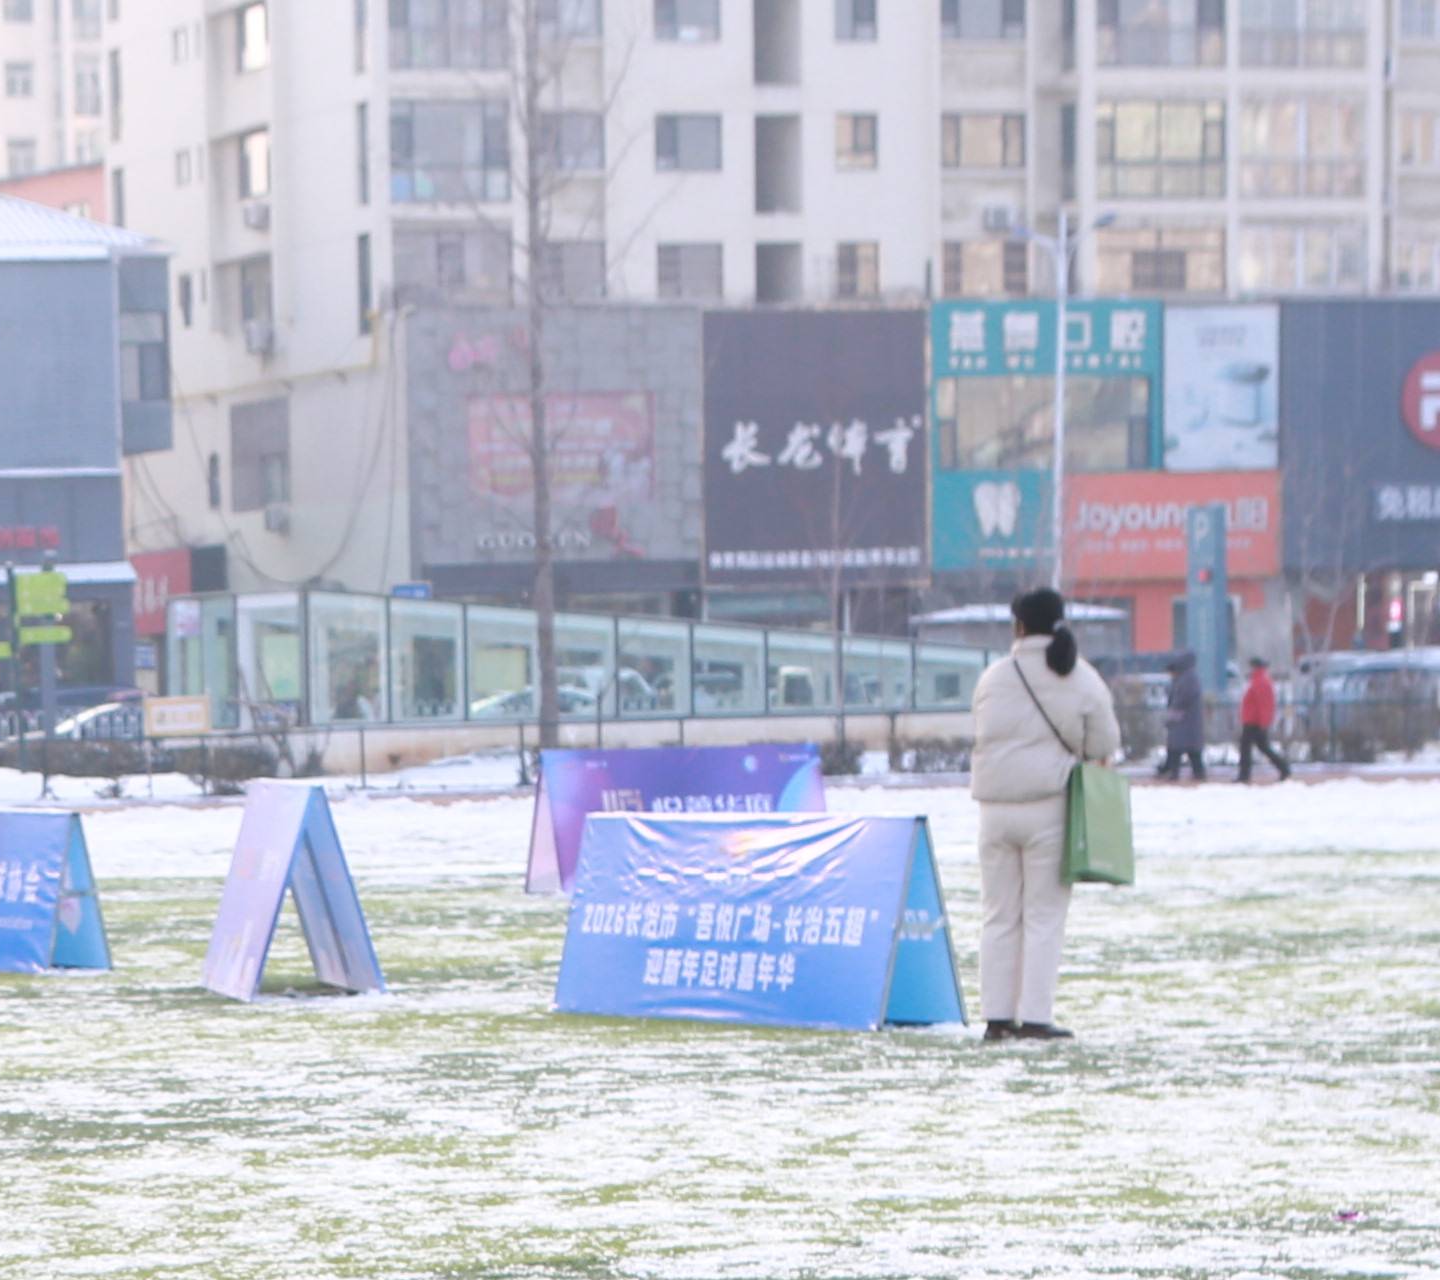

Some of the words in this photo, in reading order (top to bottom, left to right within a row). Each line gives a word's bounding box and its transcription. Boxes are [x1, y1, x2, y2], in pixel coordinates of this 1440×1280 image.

[722, 417, 914, 476] 长龙体育
[1074, 500, 1188, 535] Joyoun
[642, 948, 796, 993] 迎新年足球嘉年华
